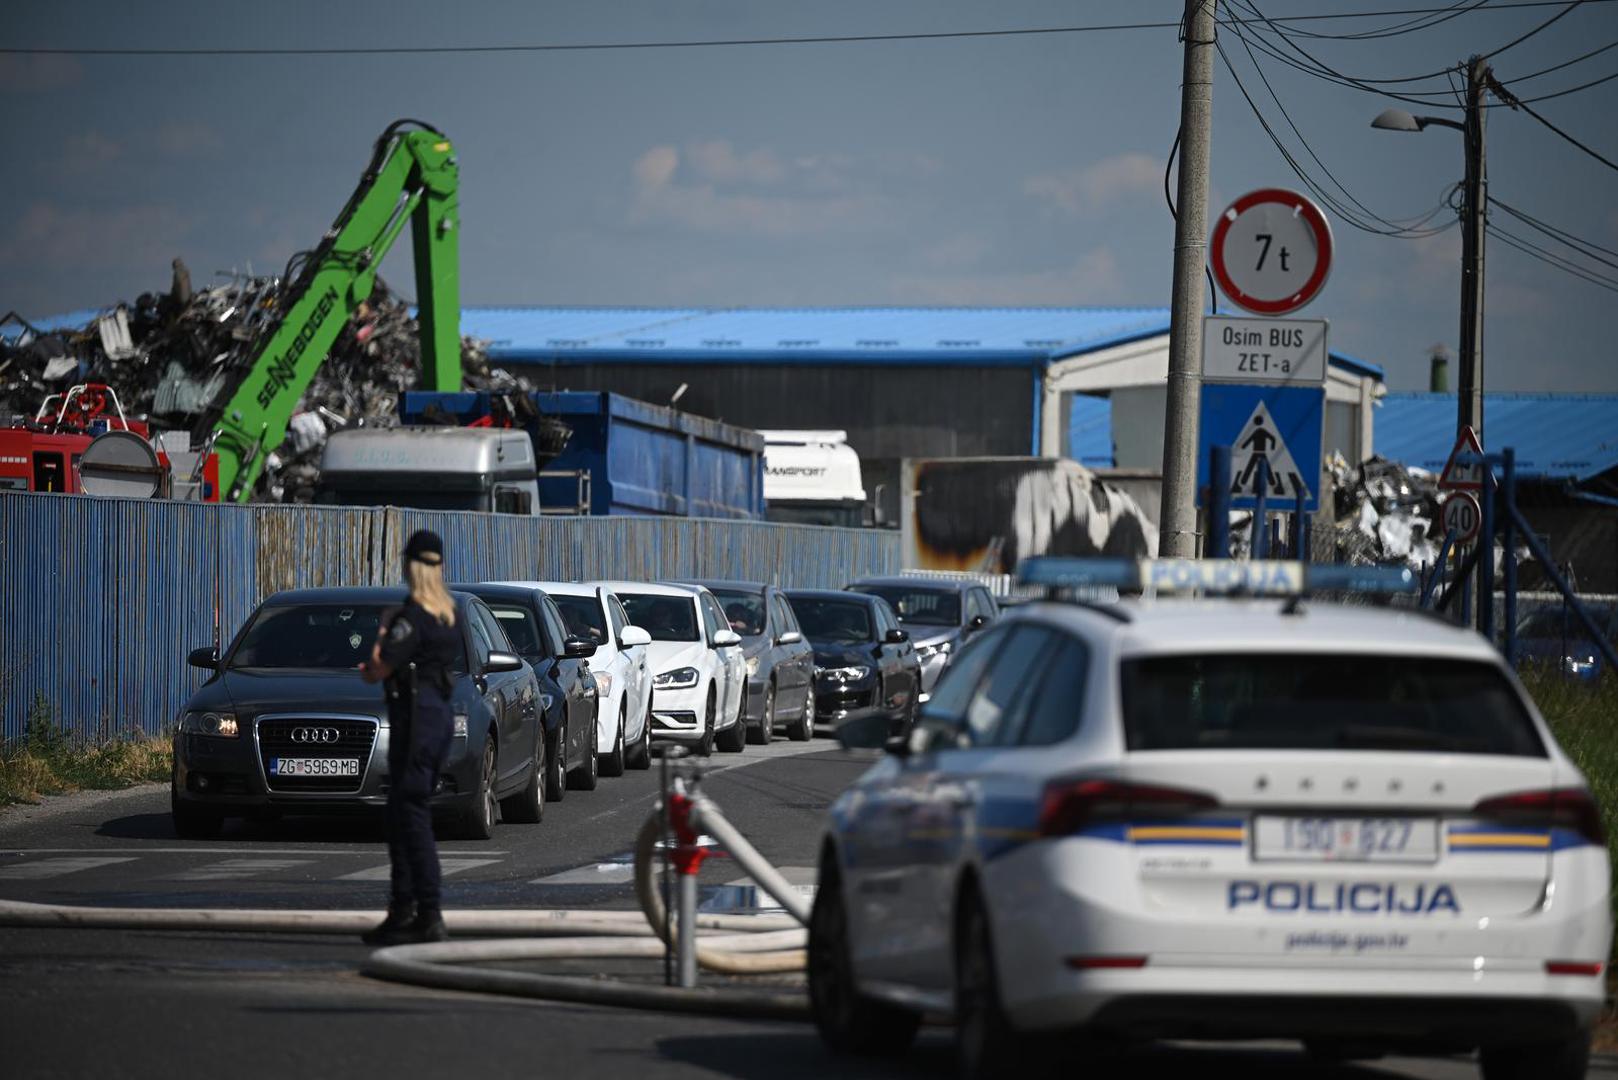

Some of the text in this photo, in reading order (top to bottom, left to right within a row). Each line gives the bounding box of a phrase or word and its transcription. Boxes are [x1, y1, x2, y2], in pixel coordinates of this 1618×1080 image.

[1255, 234, 1290, 271] 7 t
[257, 285, 338, 410] SENNEBOGEN
[1223, 326, 1303, 347] Osim BUS
[1238, 353, 1290, 373] ZET-a
[1449, 505, 1472, 532] 40
[279, 760, 295, 774] ZG
[1229, 881, 1460, 913] POLICIJA
